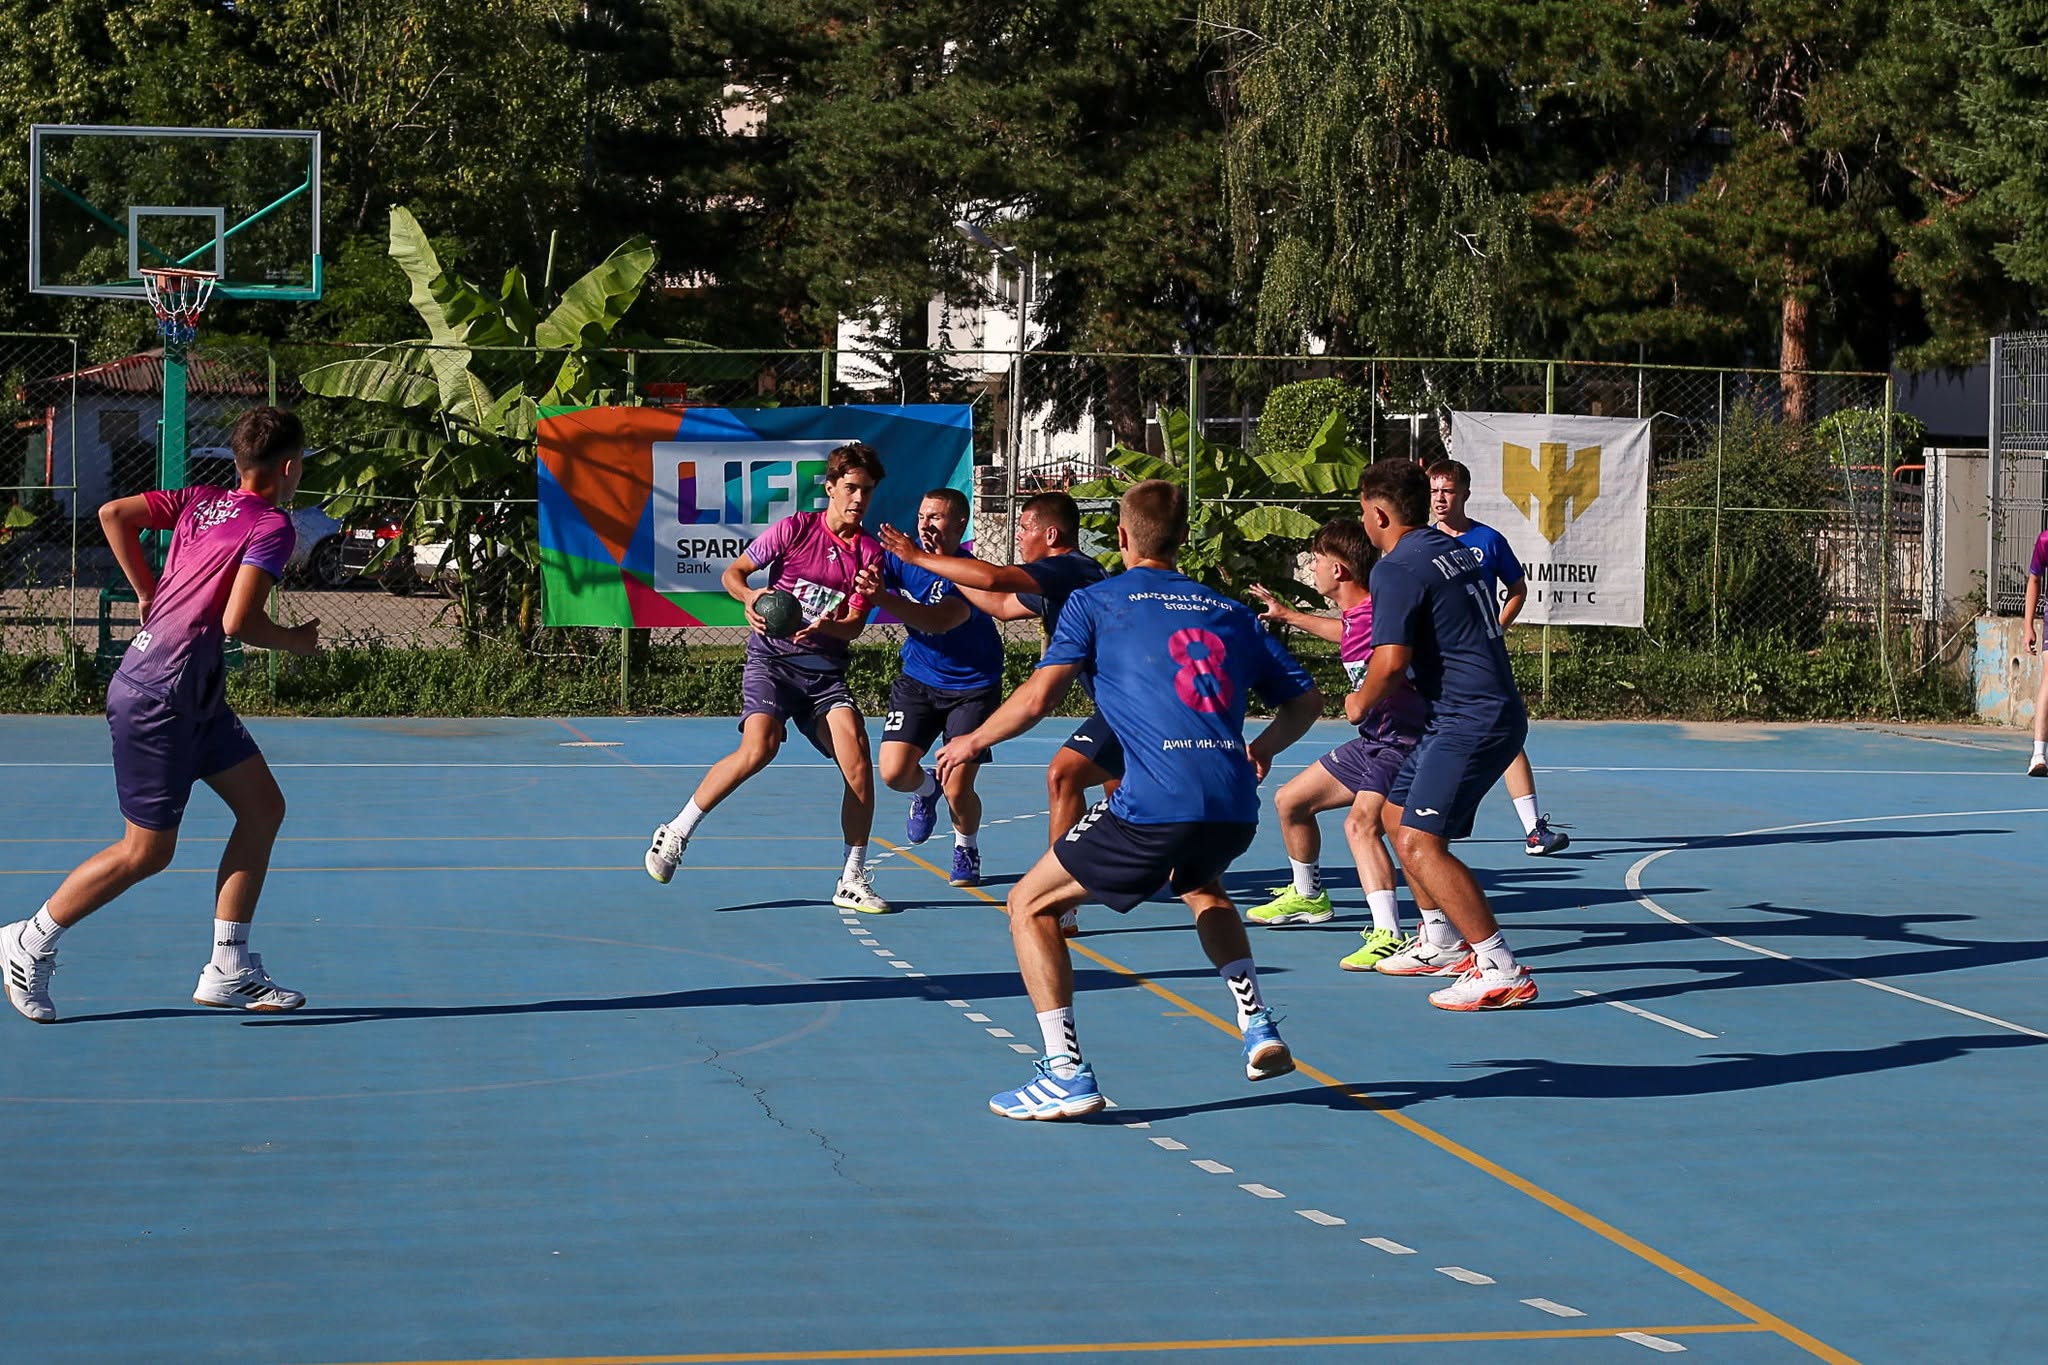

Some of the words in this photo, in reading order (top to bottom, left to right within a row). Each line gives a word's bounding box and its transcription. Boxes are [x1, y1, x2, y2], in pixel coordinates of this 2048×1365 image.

[677, 460, 829, 525] LIFE
[676, 562, 712, 574] Bank
[1538, 564, 1598, 583] MITREV
[1498, 589, 1597, 604] CINIC
[1167, 627, 1235, 714] 8
[884, 711, 905, 731] 23
